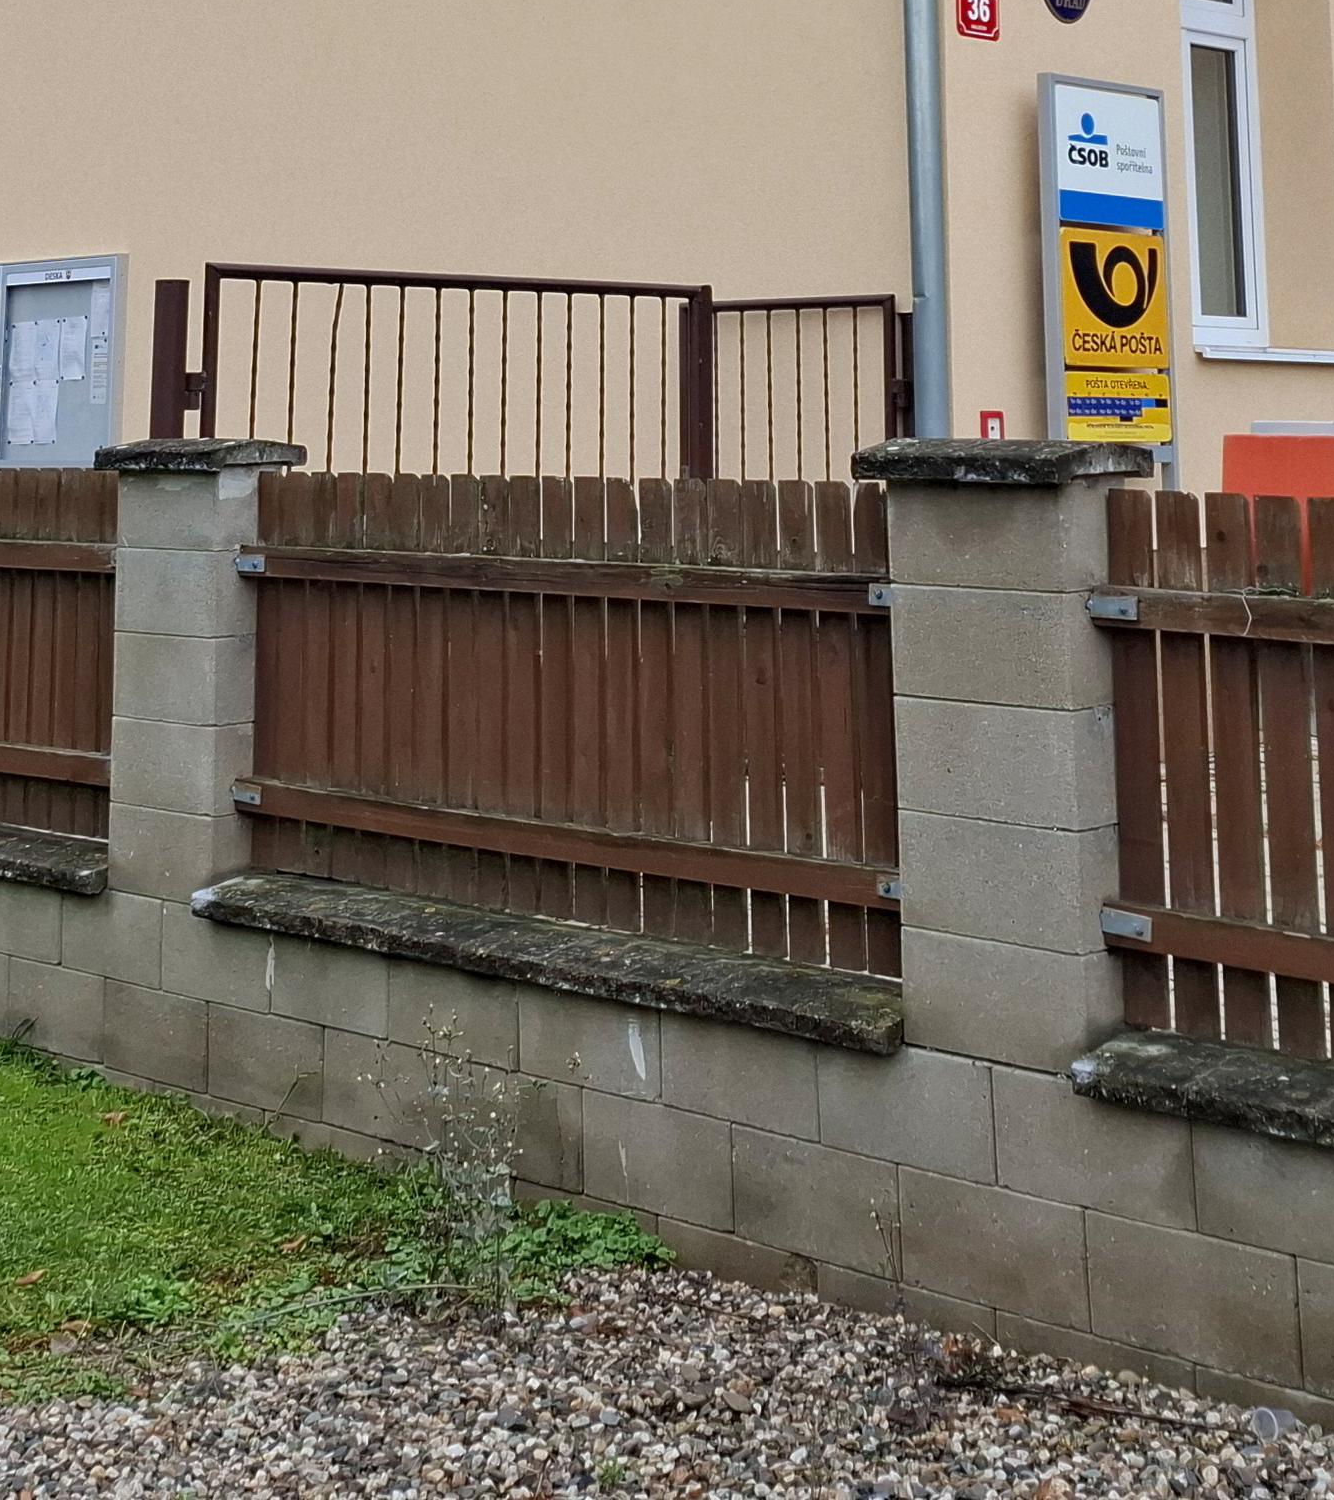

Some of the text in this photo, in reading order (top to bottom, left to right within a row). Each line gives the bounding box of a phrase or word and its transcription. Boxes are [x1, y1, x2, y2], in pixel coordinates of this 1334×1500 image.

[1068, 143, 1109, 168] ČSOB
[1116, 144, 1147, 159] Poštovní
[1116, 160, 1153, 175] spořitelna
[44, 272, 63, 281] DESKA
[1072, 329, 1163, 355] ČESKÁ POŠTA
[1085, 377, 1109, 389] POŠTA
